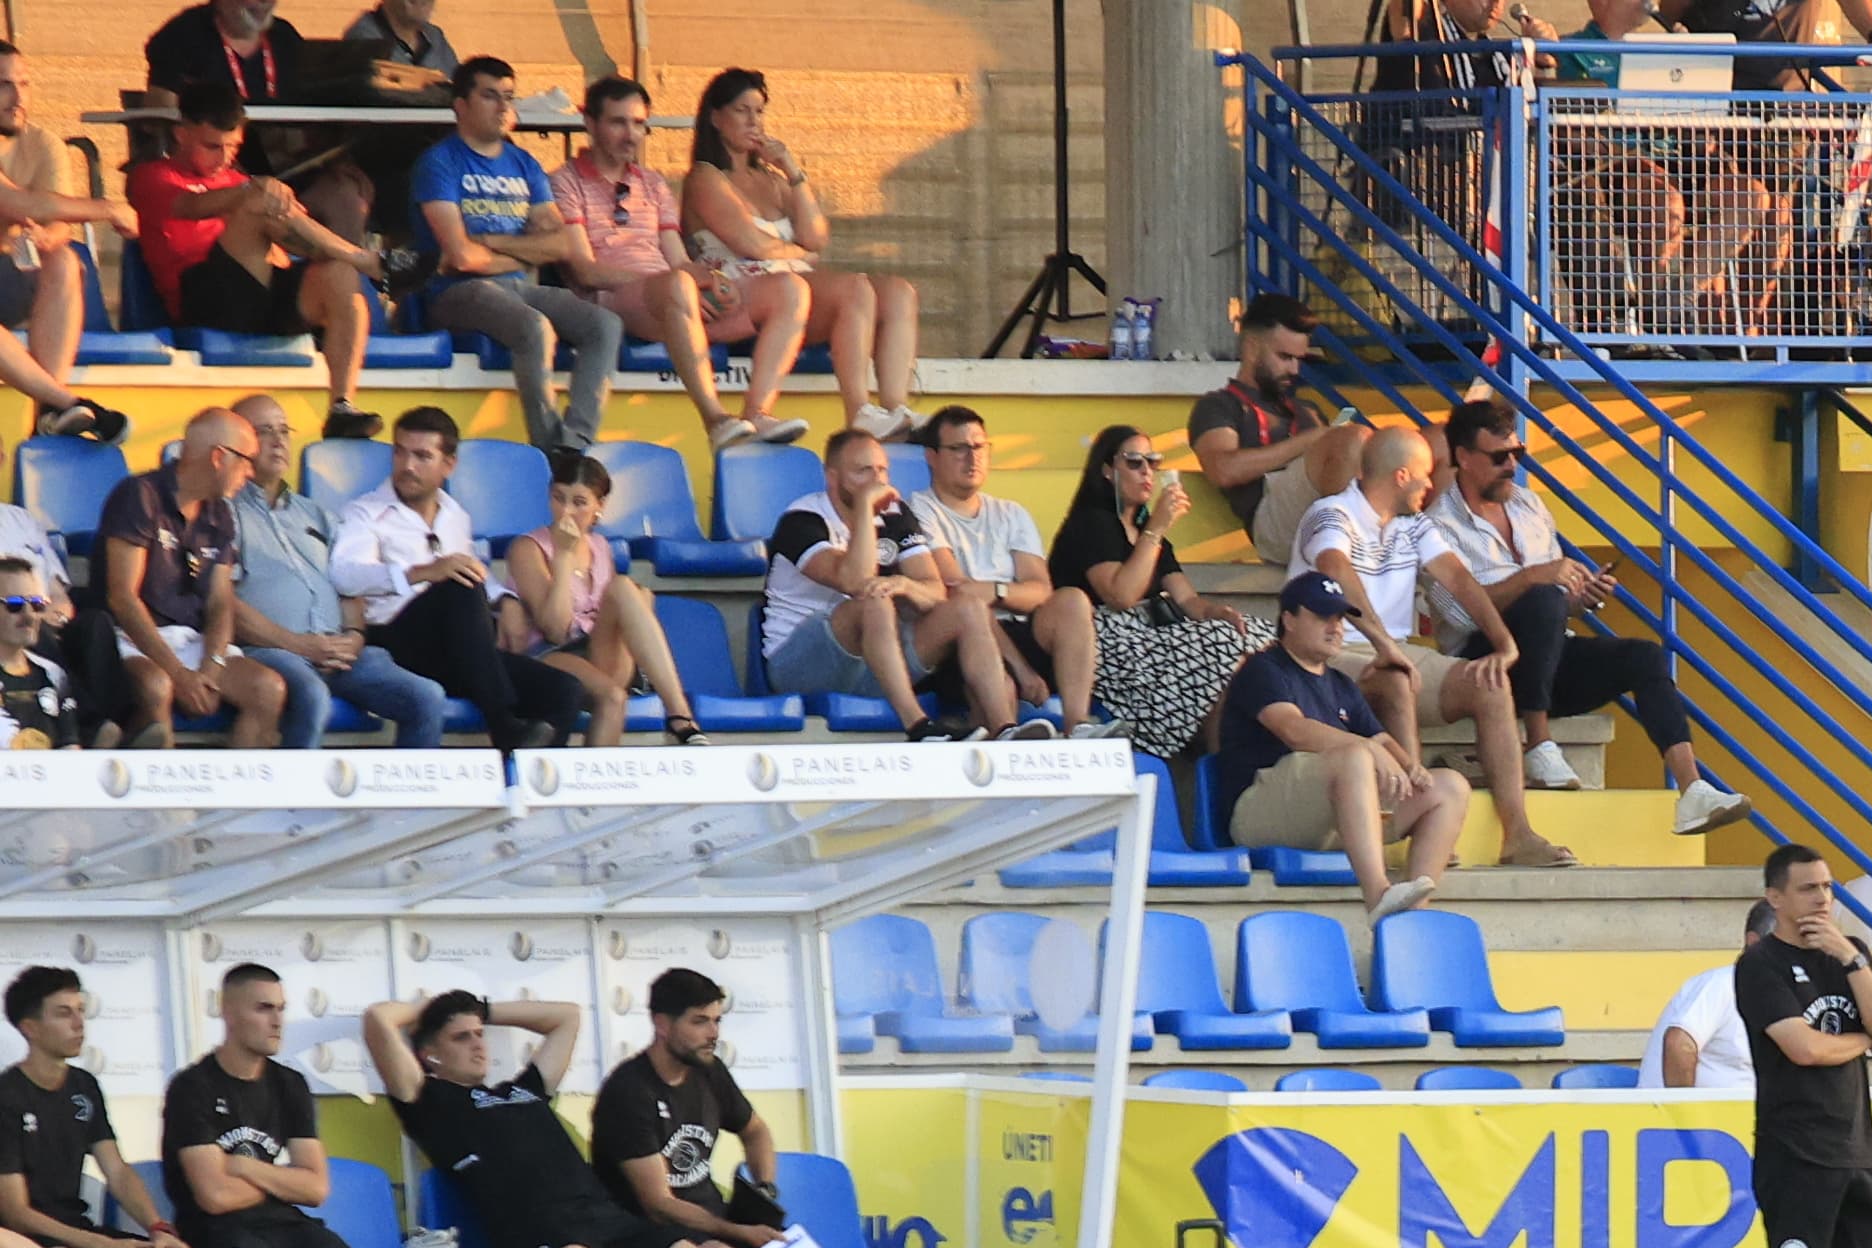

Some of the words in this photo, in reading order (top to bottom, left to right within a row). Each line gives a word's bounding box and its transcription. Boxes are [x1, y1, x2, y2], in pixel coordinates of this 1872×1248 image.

[574, 759, 696, 779] PANELAIS
[793, 754, 912, 775] PANELAIS
[1009, 751, 1127, 769] PANELAIS
[147, 762, 274, 782] PANELAIS
[372, 762, 497, 781] PANELAIS
